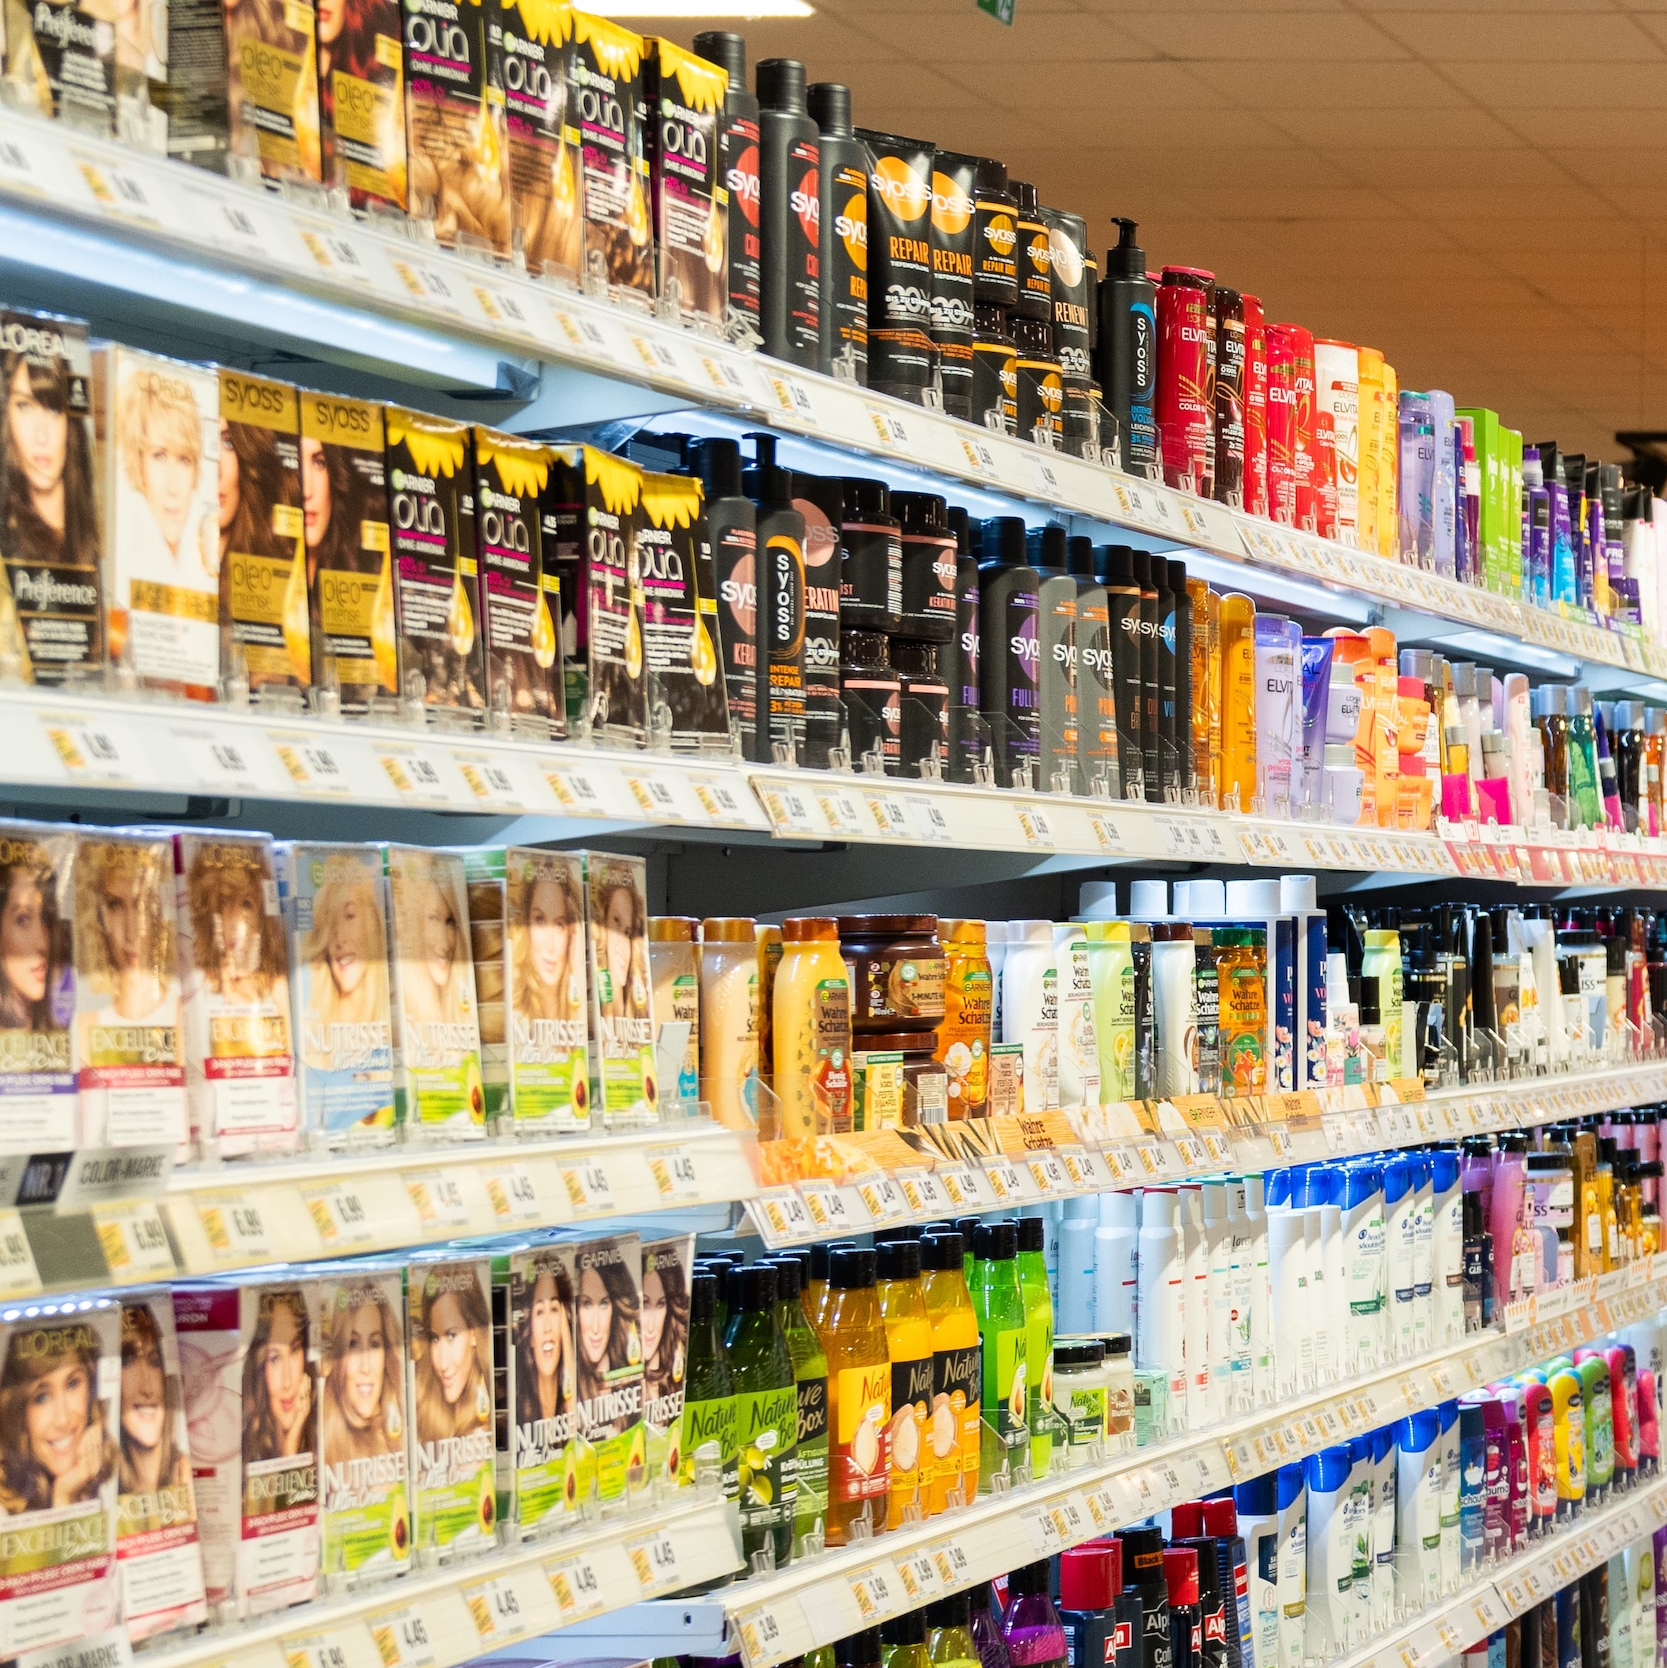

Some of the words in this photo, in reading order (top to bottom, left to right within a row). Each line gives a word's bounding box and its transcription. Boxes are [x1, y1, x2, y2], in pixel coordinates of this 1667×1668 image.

[889, 236, 930, 264] REPAIR
[984, 227, 1017, 246] syoss
[933, 249, 973, 277] REPAIR
[769, 664, 799, 676] INTENSE
[577, 1386, 642, 1425] NUTRISSE
[516, 1411, 575, 1447] NUTRISSE
